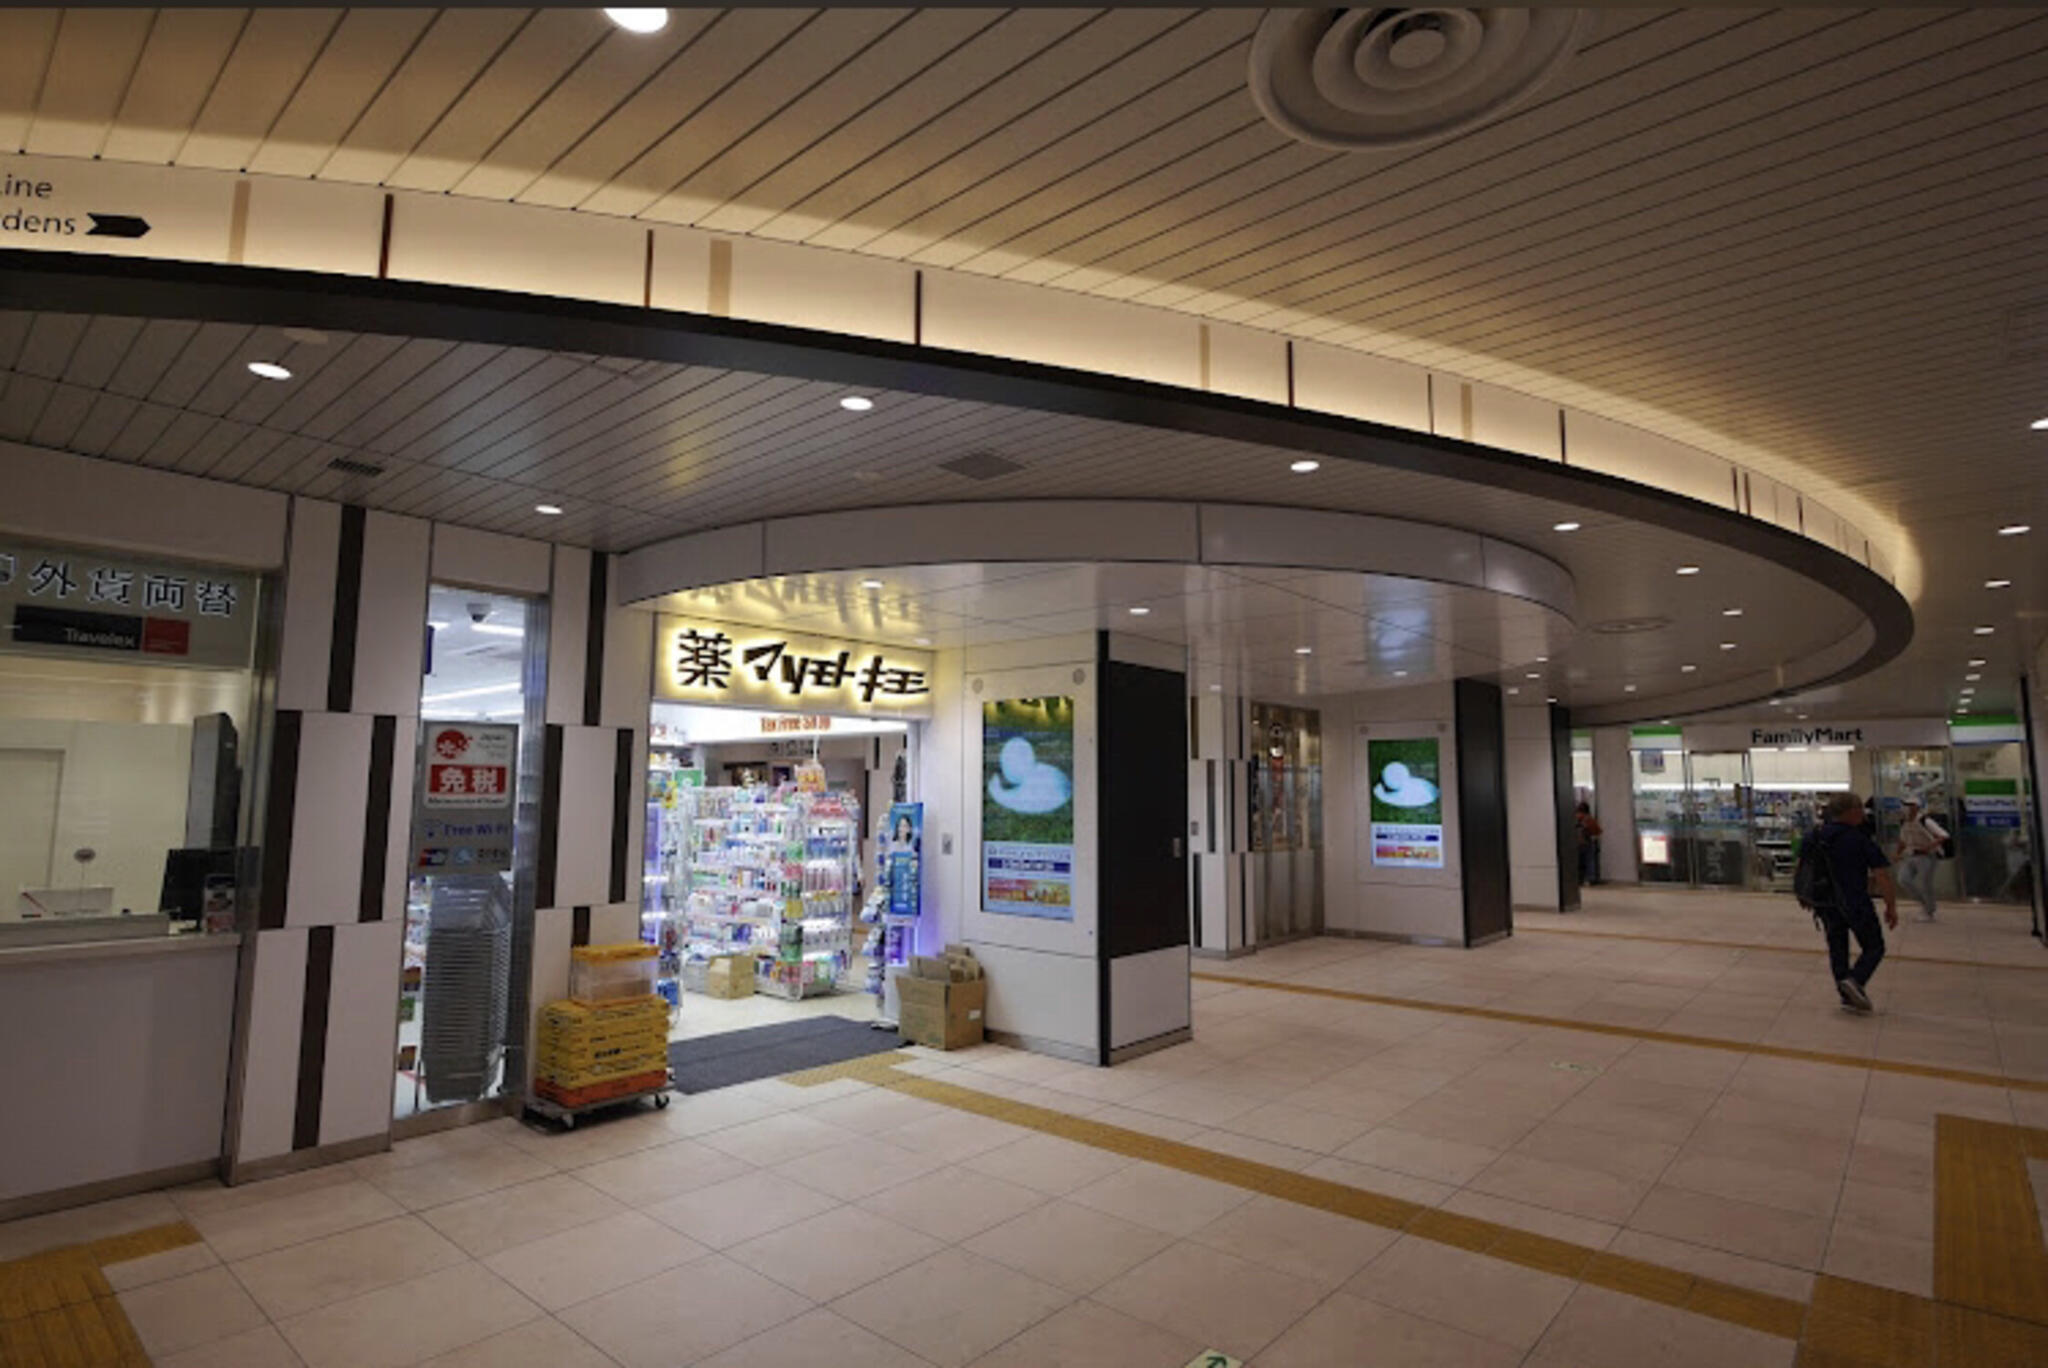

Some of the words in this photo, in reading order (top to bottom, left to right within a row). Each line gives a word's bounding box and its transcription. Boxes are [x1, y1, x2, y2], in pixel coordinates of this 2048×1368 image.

[0, 173, 53, 199] ine
[1752, 727, 1864, 745] FamilyMart
[439, 766, 498, 793] 免税
